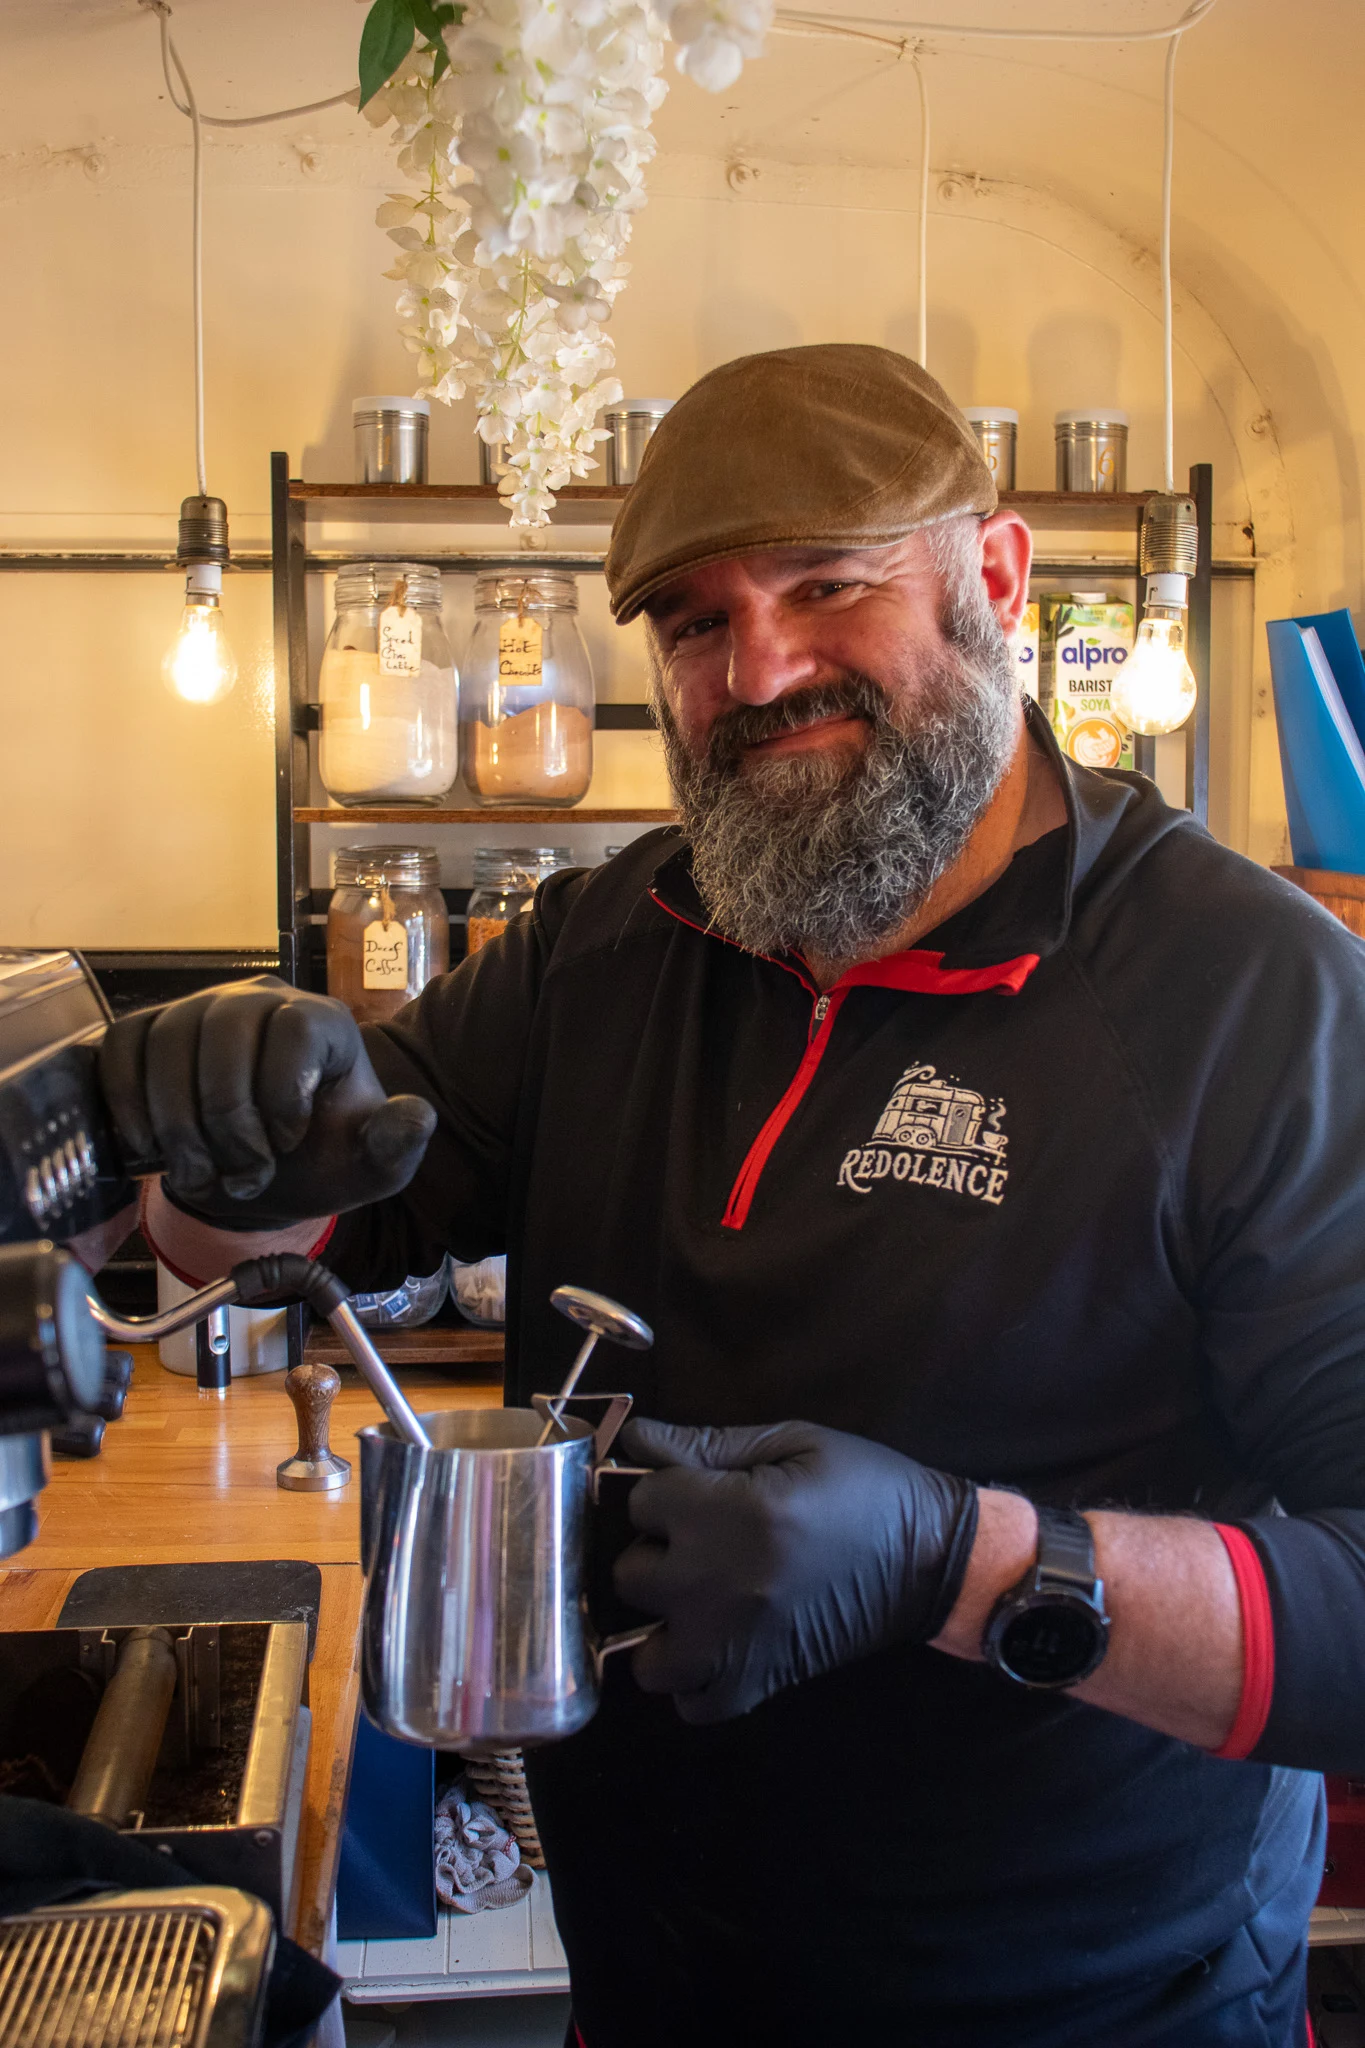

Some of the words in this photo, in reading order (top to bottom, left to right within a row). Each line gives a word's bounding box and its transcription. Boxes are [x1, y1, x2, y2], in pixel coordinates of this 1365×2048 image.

[986, 443, 998, 471] 5
[1098, 446, 1115, 476] 6
[499, 638, 539, 653] Hot
[1062, 639, 1128, 671] alpro
[1068, 680, 1113, 693] BARIST
[1080, 699, 1111, 711] SOYA
[365, 940, 404, 961] Decaf
[365, 958, 404, 976] Coffee
[836, 1149, 1009, 1205] REDOLENCE
